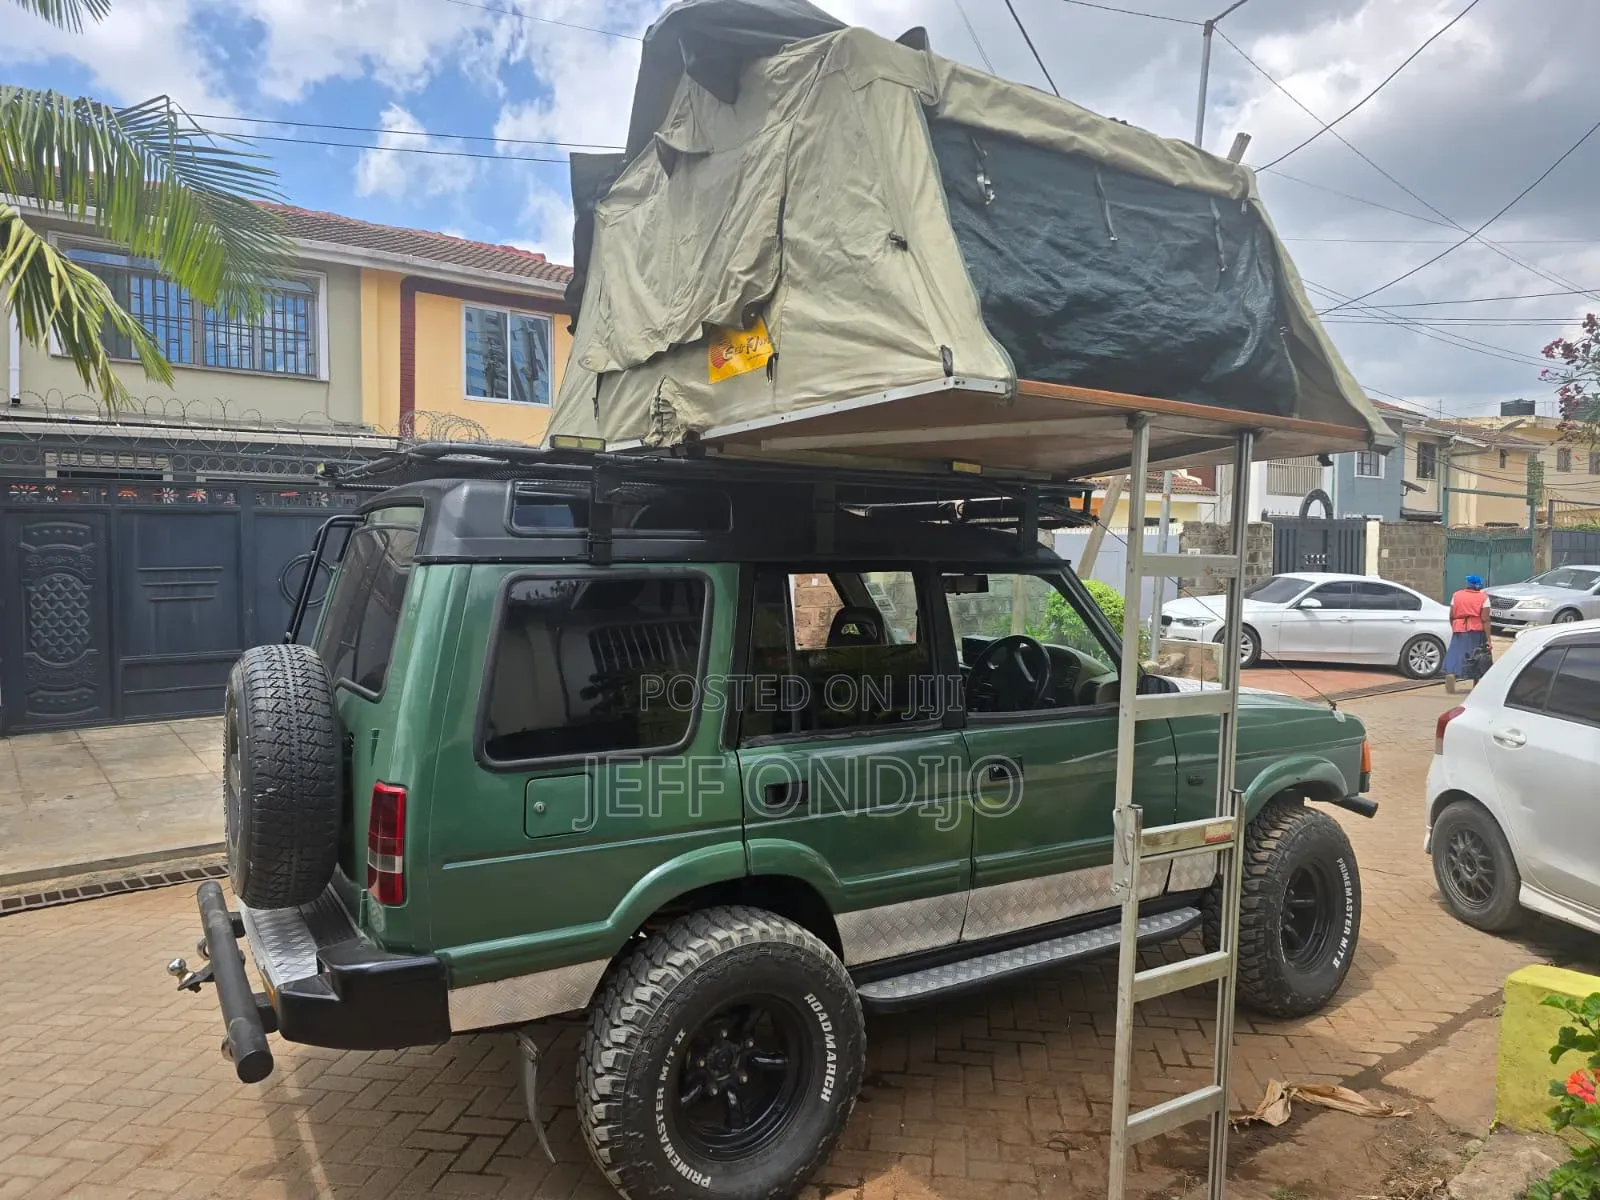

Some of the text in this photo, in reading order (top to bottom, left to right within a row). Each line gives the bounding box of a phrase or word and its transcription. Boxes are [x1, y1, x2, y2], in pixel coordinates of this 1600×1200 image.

[1336, 857, 1353, 936] PRIMEMASTER
[1337, 936, 1349, 959] M/T
[659, 1046, 676, 1081] M/T
[804, 993, 837, 1103] ROADMARCH
[655, 1087, 712, 1189] PRIMEMASTER
